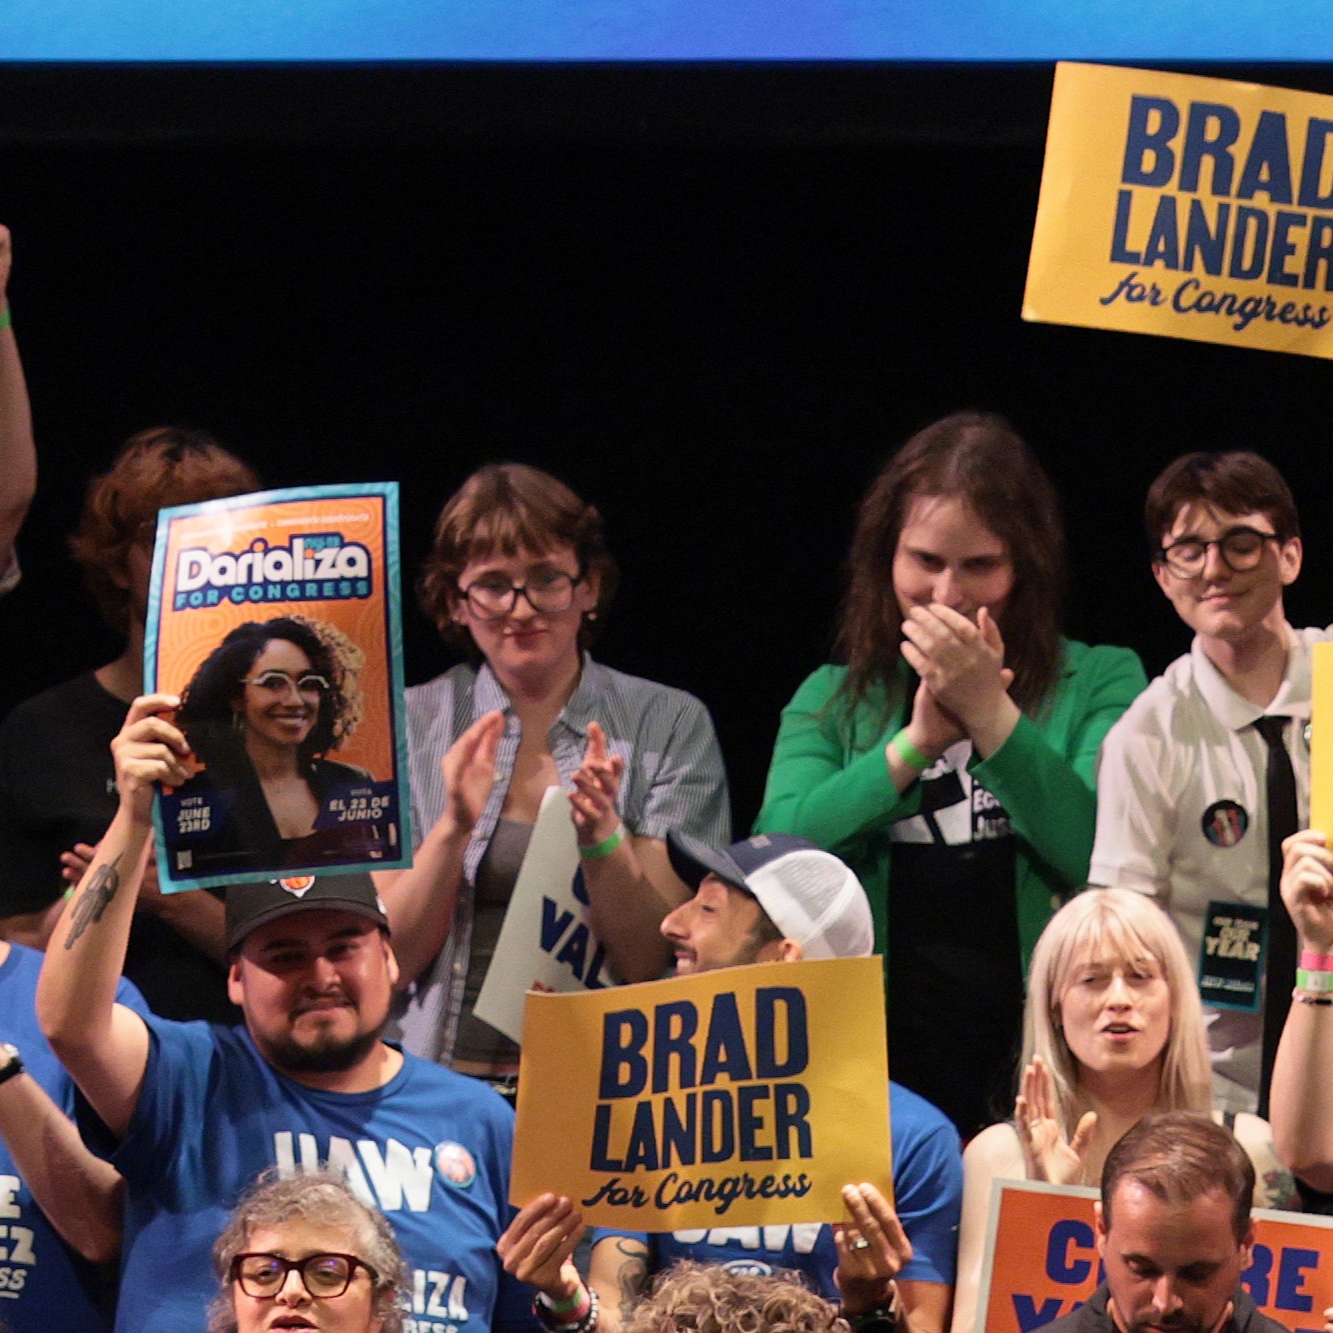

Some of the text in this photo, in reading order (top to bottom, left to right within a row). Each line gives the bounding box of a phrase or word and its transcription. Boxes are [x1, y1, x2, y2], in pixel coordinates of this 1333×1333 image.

[1100, 271, 1331, 331] for Congress
[175, 580, 368, 607] FOR CONGRESS
[176, 537, 369, 592] Darializa
[598, 986, 811, 1101] BRAD
[589, 1082, 813, 1174] LANDER
[581, 1171, 813, 1216] for Congress
[1045, 1218, 1321, 1313] CRE
